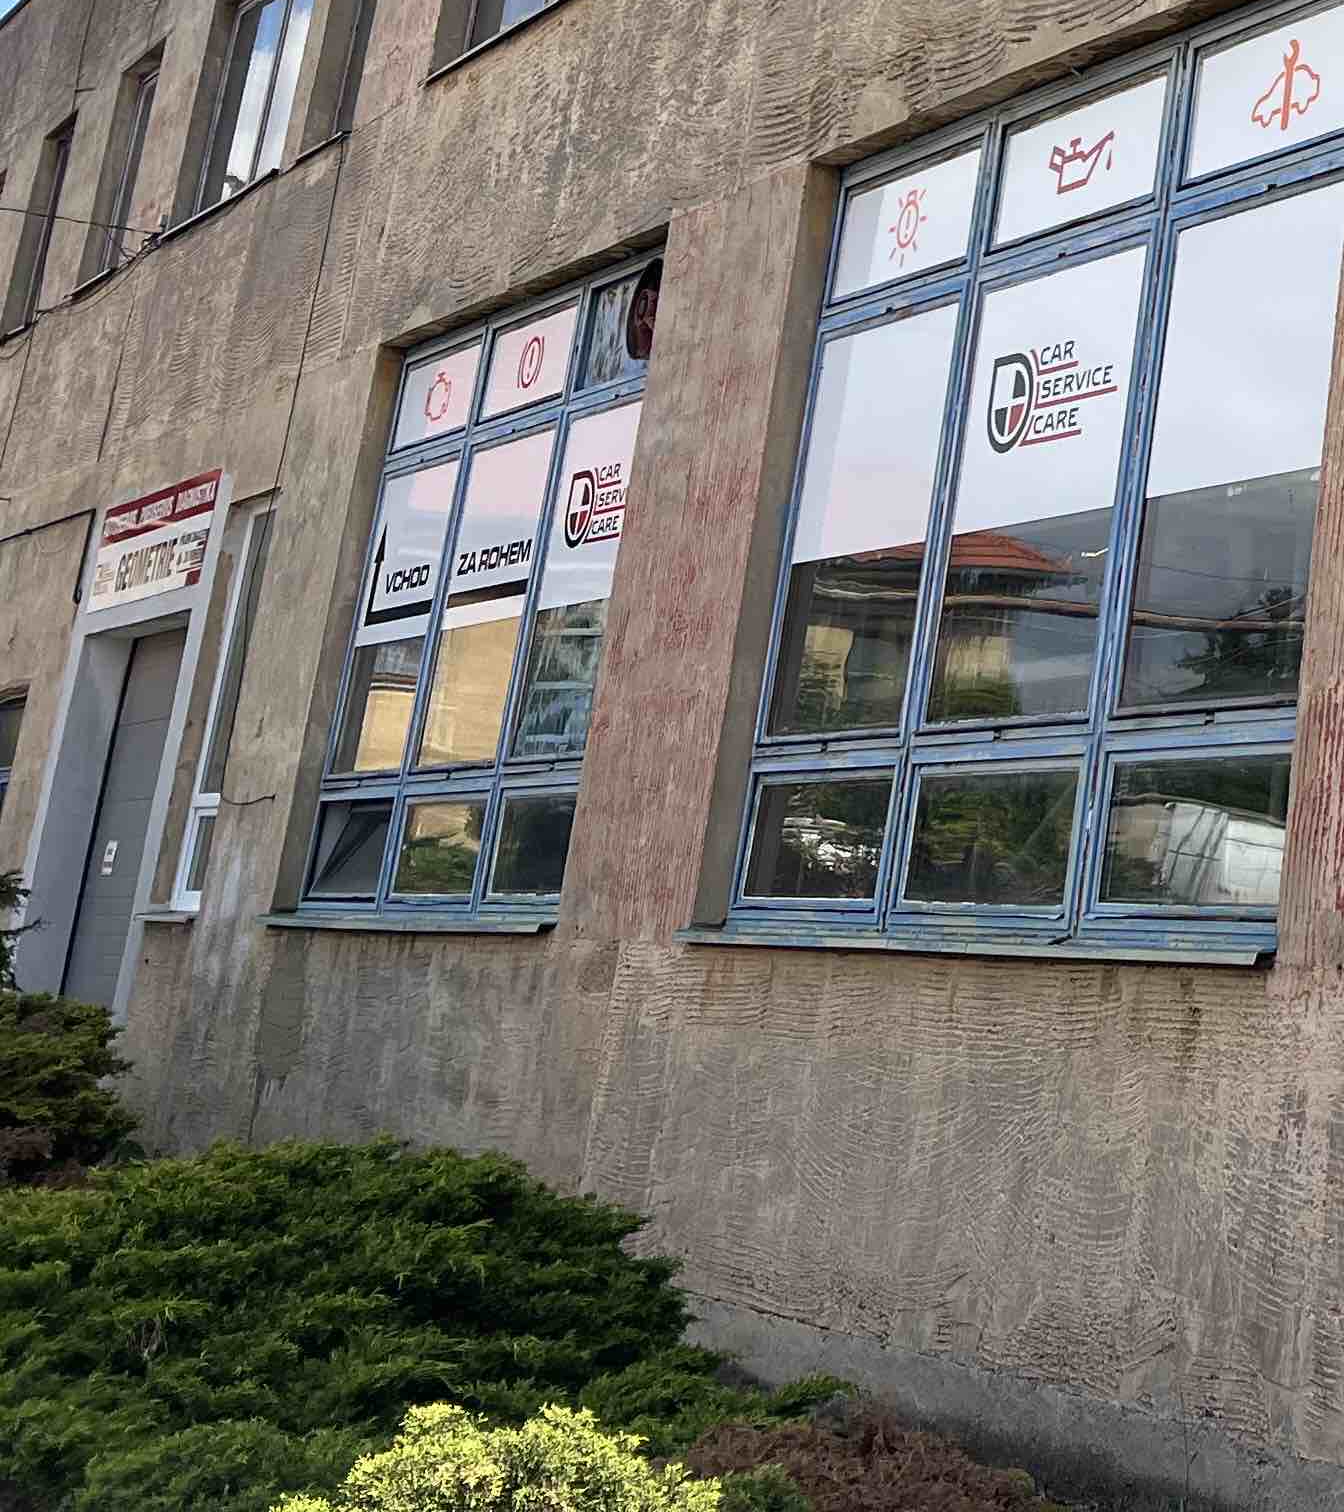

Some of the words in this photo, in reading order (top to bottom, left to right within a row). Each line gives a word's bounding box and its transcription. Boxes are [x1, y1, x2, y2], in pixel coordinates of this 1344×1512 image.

[1040, 340, 1075, 365] CAR
[1041, 364, 1114, 399] SERVICE
[1033, 407, 1080, 434] CARE
[599, 463, 622, 481] CAR
[598, 489, 626, 507] SERV
[591, 515, 620, 535] CARE
[385, 564, 431, 595] VCHOD
[456, 552, 476, 577] ZA
[477, 538, 533, 573] ROHEM
